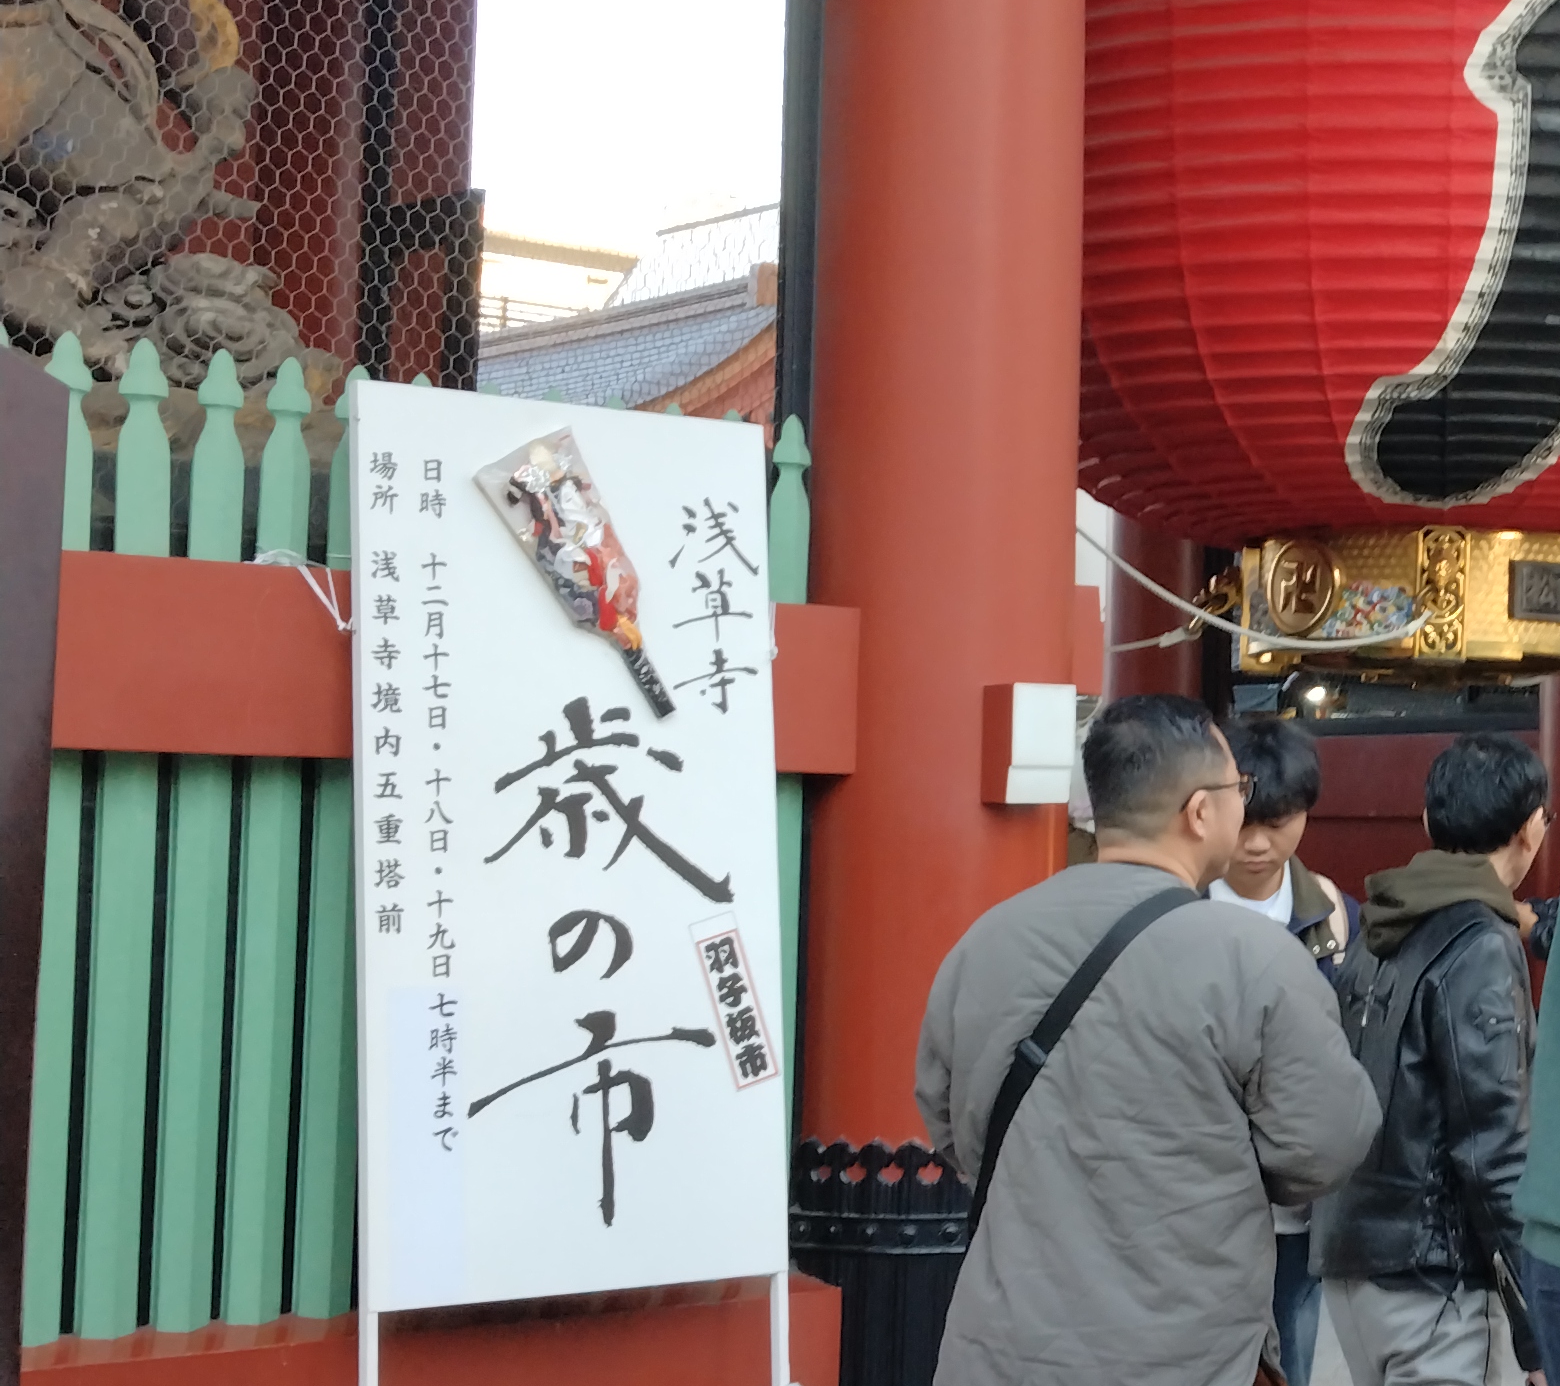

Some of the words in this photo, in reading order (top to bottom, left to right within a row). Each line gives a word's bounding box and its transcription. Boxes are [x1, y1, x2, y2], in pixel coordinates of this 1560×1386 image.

[369, 451, 399, 515] 場所
[418, 458, 447, 519] 日時
[668, 497, 760, 714] 浅草寺
[370, 550, 405, 935] 浅草寺境内五重塔前
[467, 696, 735, 1228] 歳の市
[704, 936, 768, 1079] 羽子板市
